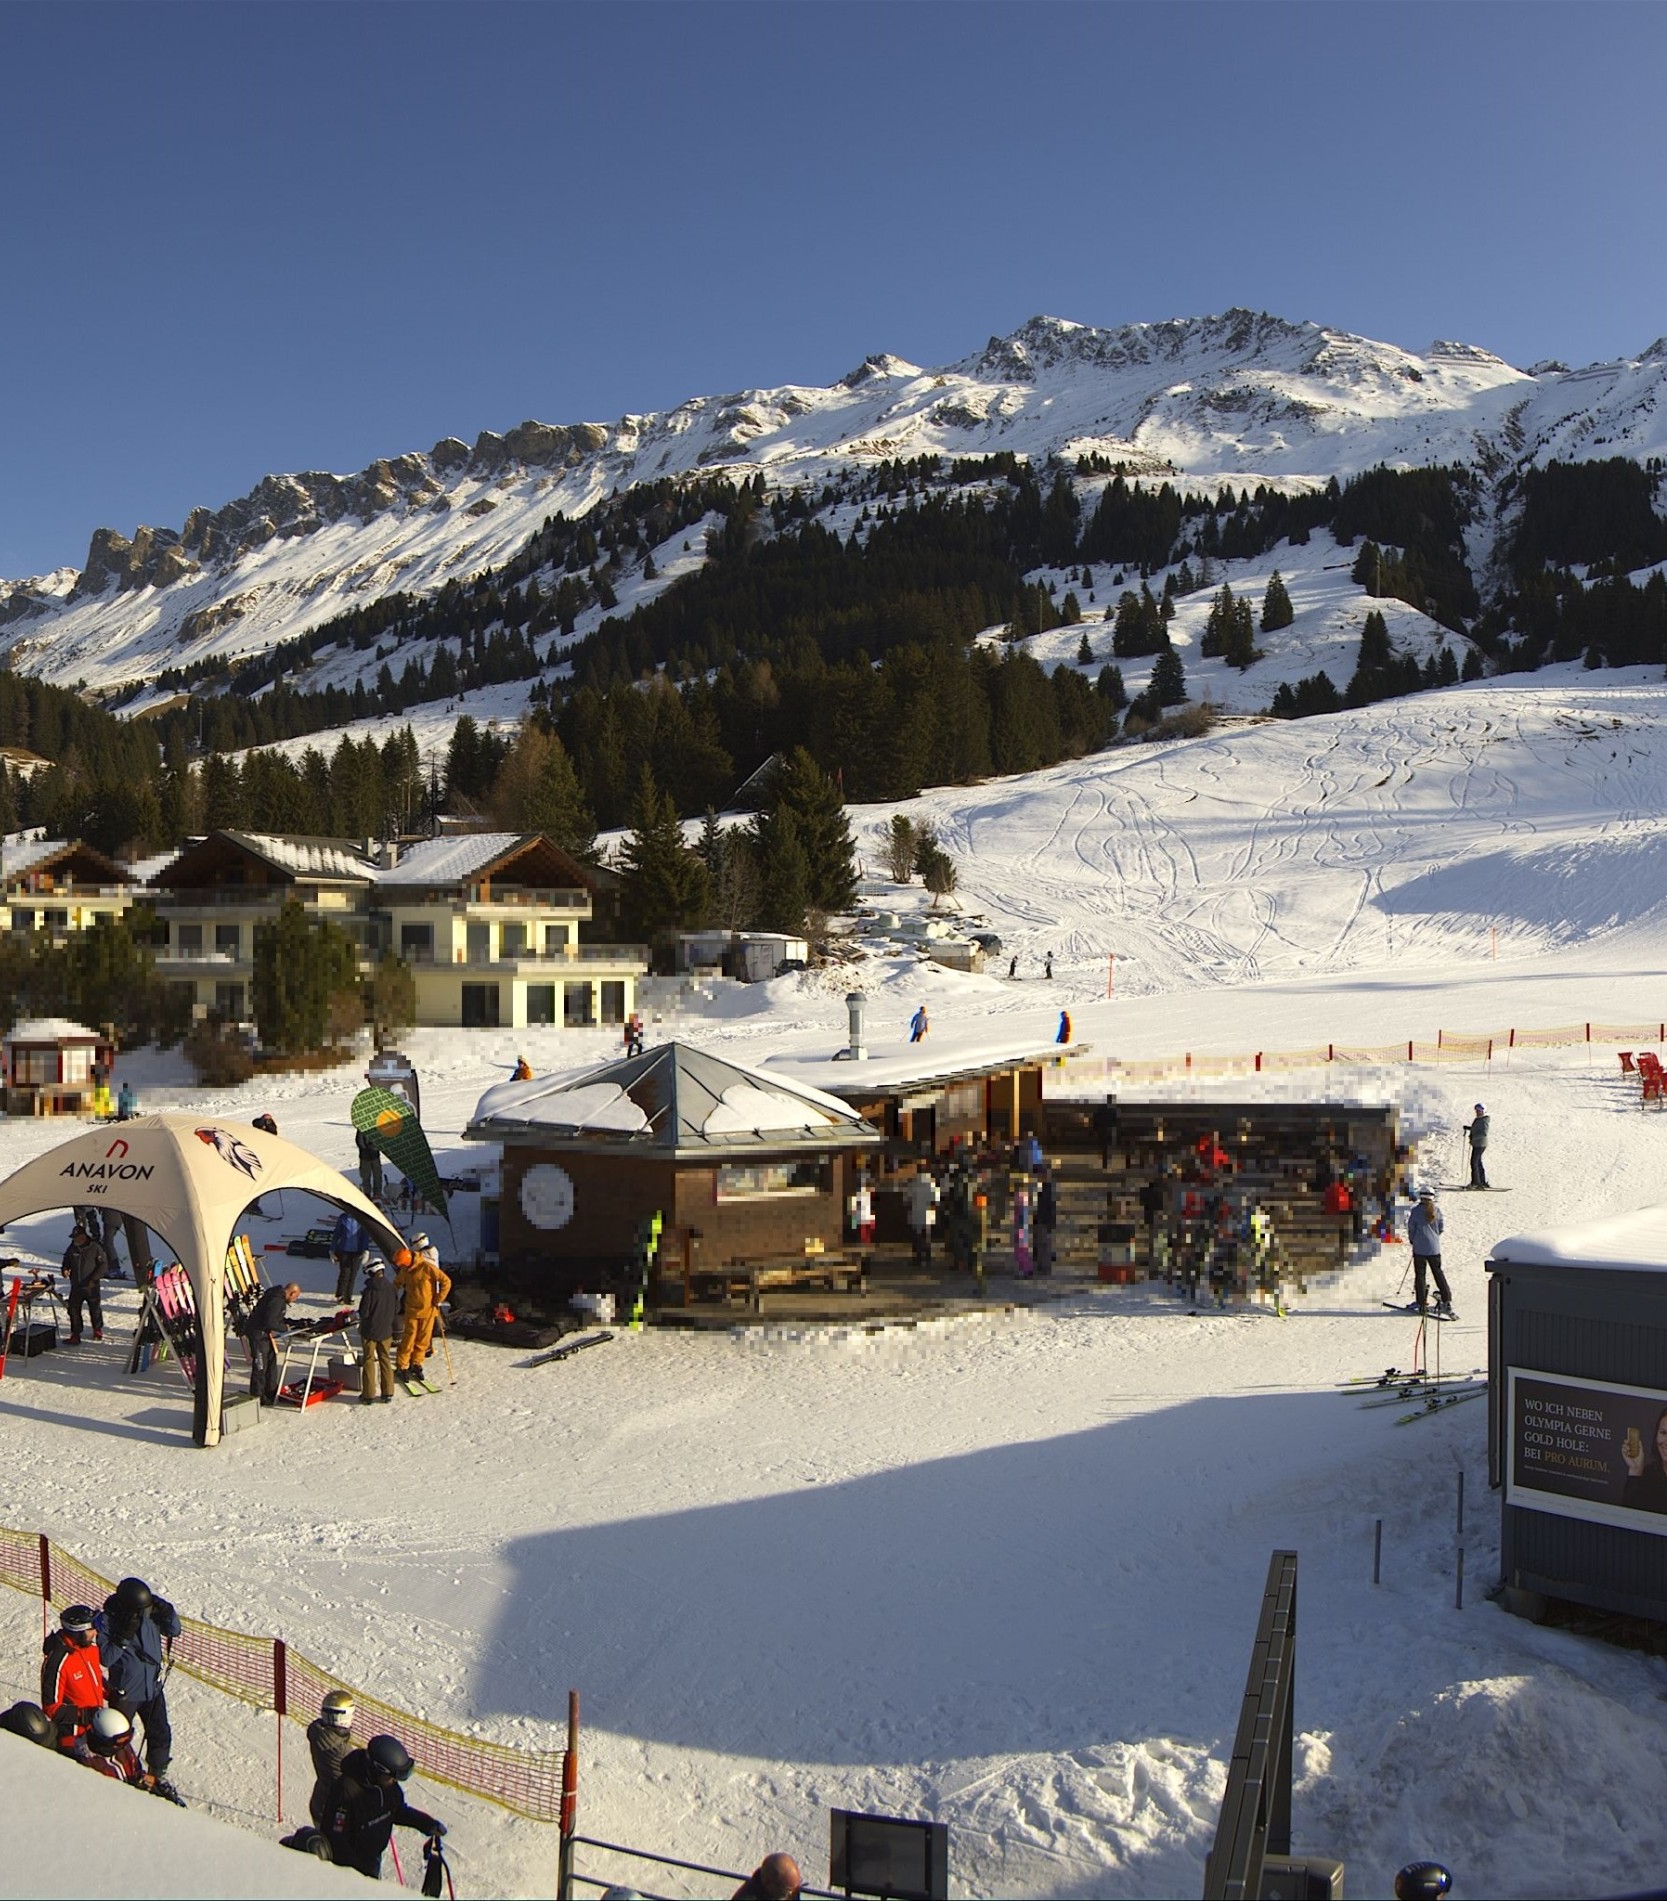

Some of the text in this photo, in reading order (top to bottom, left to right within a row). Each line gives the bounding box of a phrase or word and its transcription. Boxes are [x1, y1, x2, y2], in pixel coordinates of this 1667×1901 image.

[59, 1162, 155, 1180] ANAVON
[86, 1184, 108, 1193] SKI
[1525, 1398, 1603, 1421] WO ICH NEBEN
[1524, 1415, 1612, 1440] OLYMPIA GERNE
[1524, 1431, 1589, 1453] GOLD HOLE:
[1524, 1447, 1610, 1473] BEI PRO AURUM.
